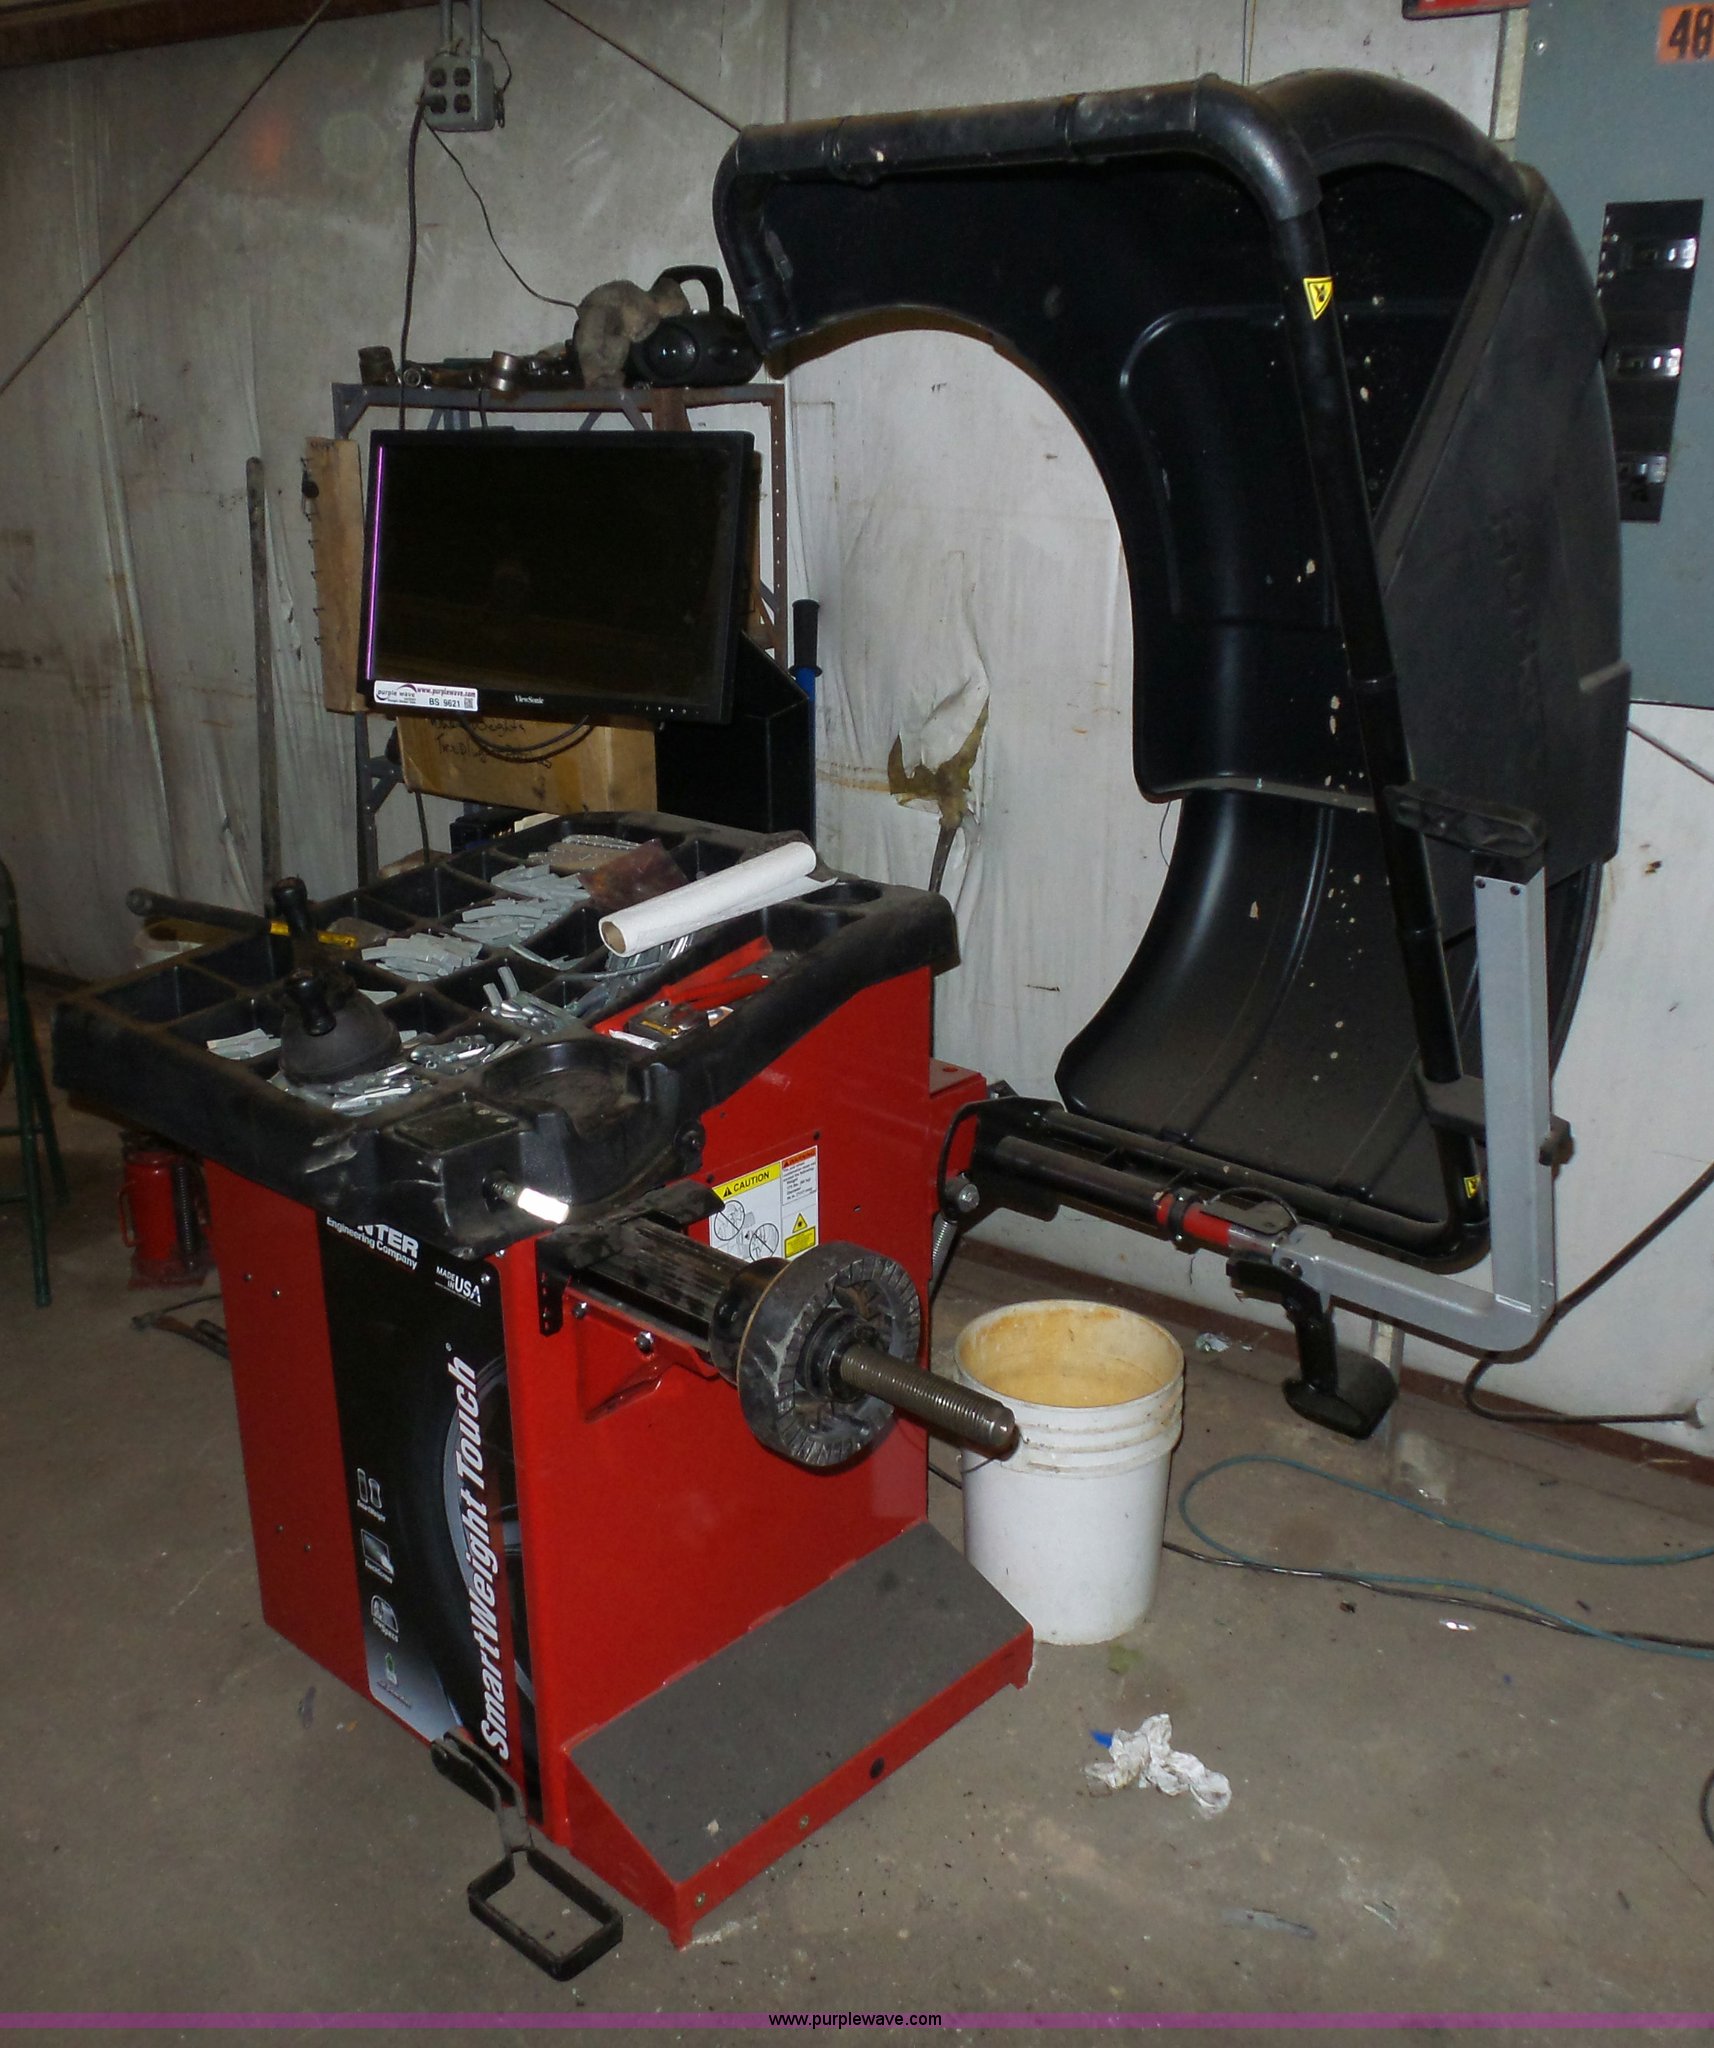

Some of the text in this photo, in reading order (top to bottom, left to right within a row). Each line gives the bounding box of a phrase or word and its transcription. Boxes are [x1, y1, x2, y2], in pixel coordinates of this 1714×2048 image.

[377, 689, 397, 697] purple
[417, 688, 476, 698] www.purplewave.com
[429, 698, 461, 708] BS 9621
[733, 1171, 770, 1192] CAUTION
[326, 1216, 418, 1270] Engineering Company
[436, 1265, 455, 1281] MADE
[447, 1280, 455, 1290] IN
[455, 1275, 481, 1304] USA
[448, 1356, 485, 1490] Touch
[460, 1488, 509, 1760] SmartWeight
